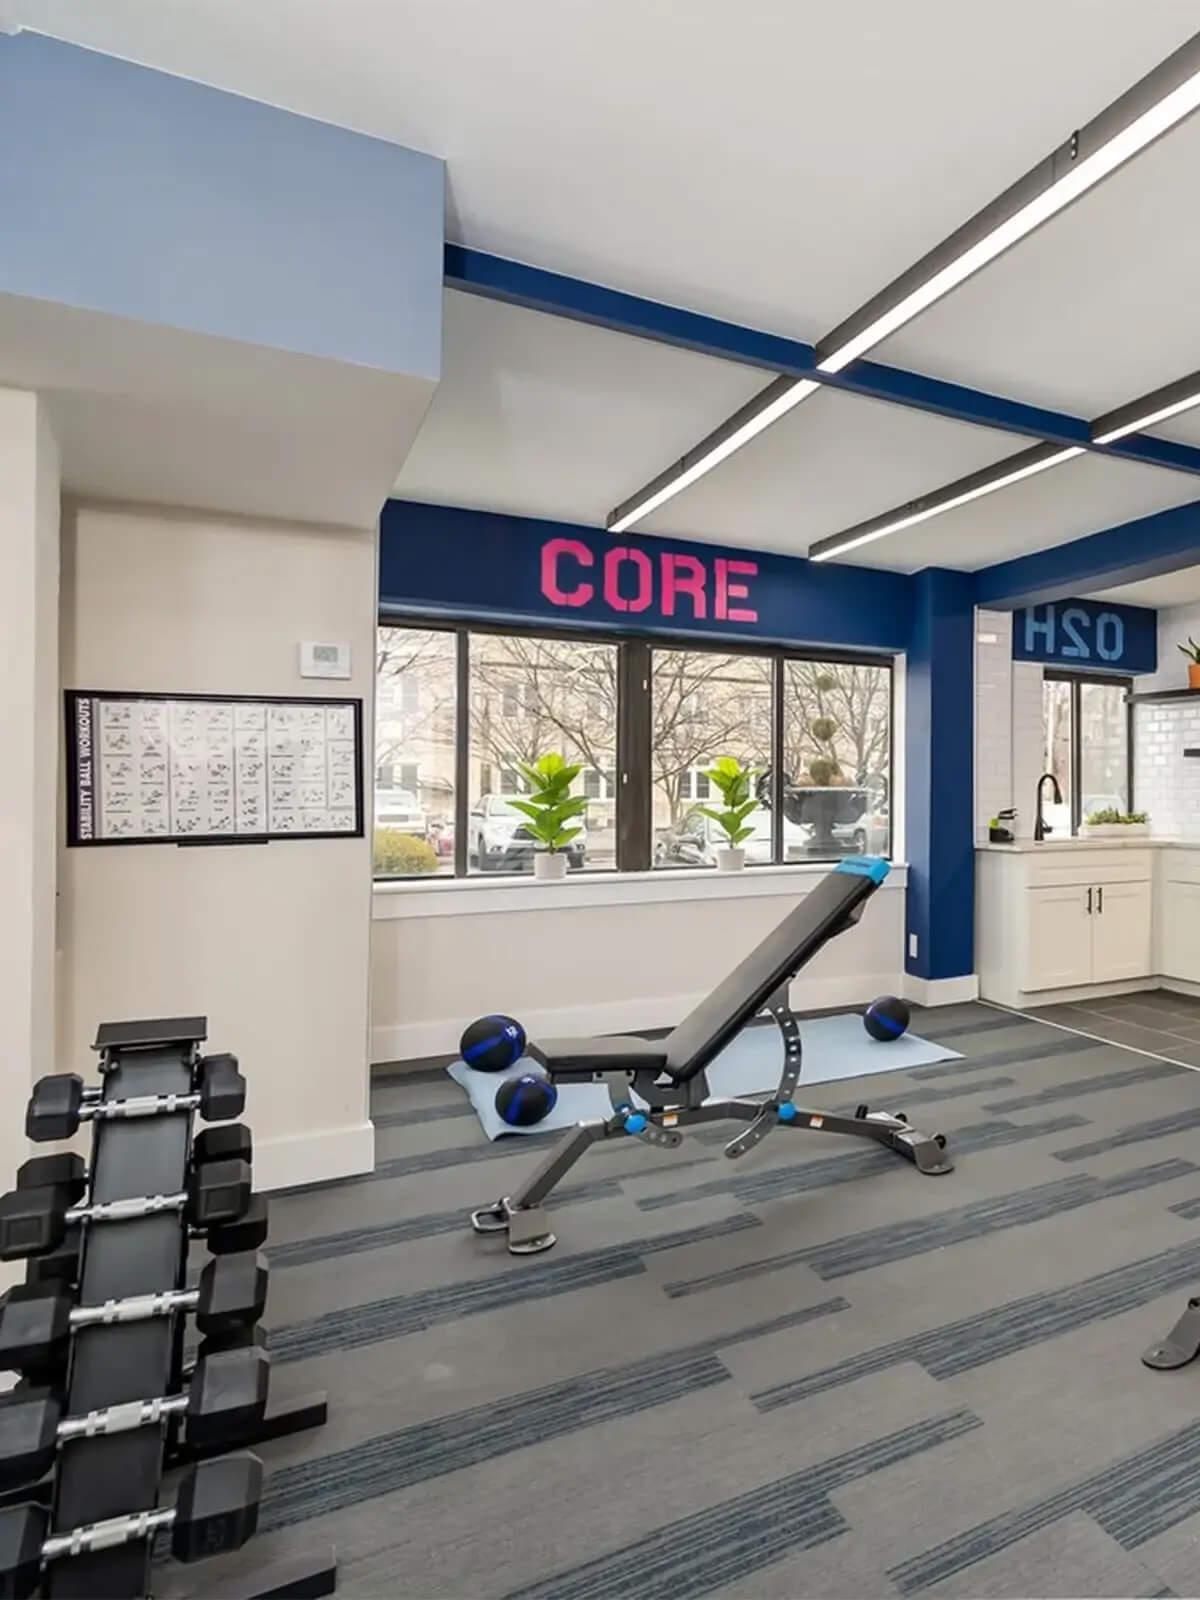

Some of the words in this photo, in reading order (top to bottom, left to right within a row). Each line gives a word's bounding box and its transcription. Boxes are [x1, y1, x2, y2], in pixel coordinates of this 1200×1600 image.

[541, 538, 758, 622] CORE
[78, 698, 91, 758] WORKOUTS
[79, 760, 92, 787] BALL
